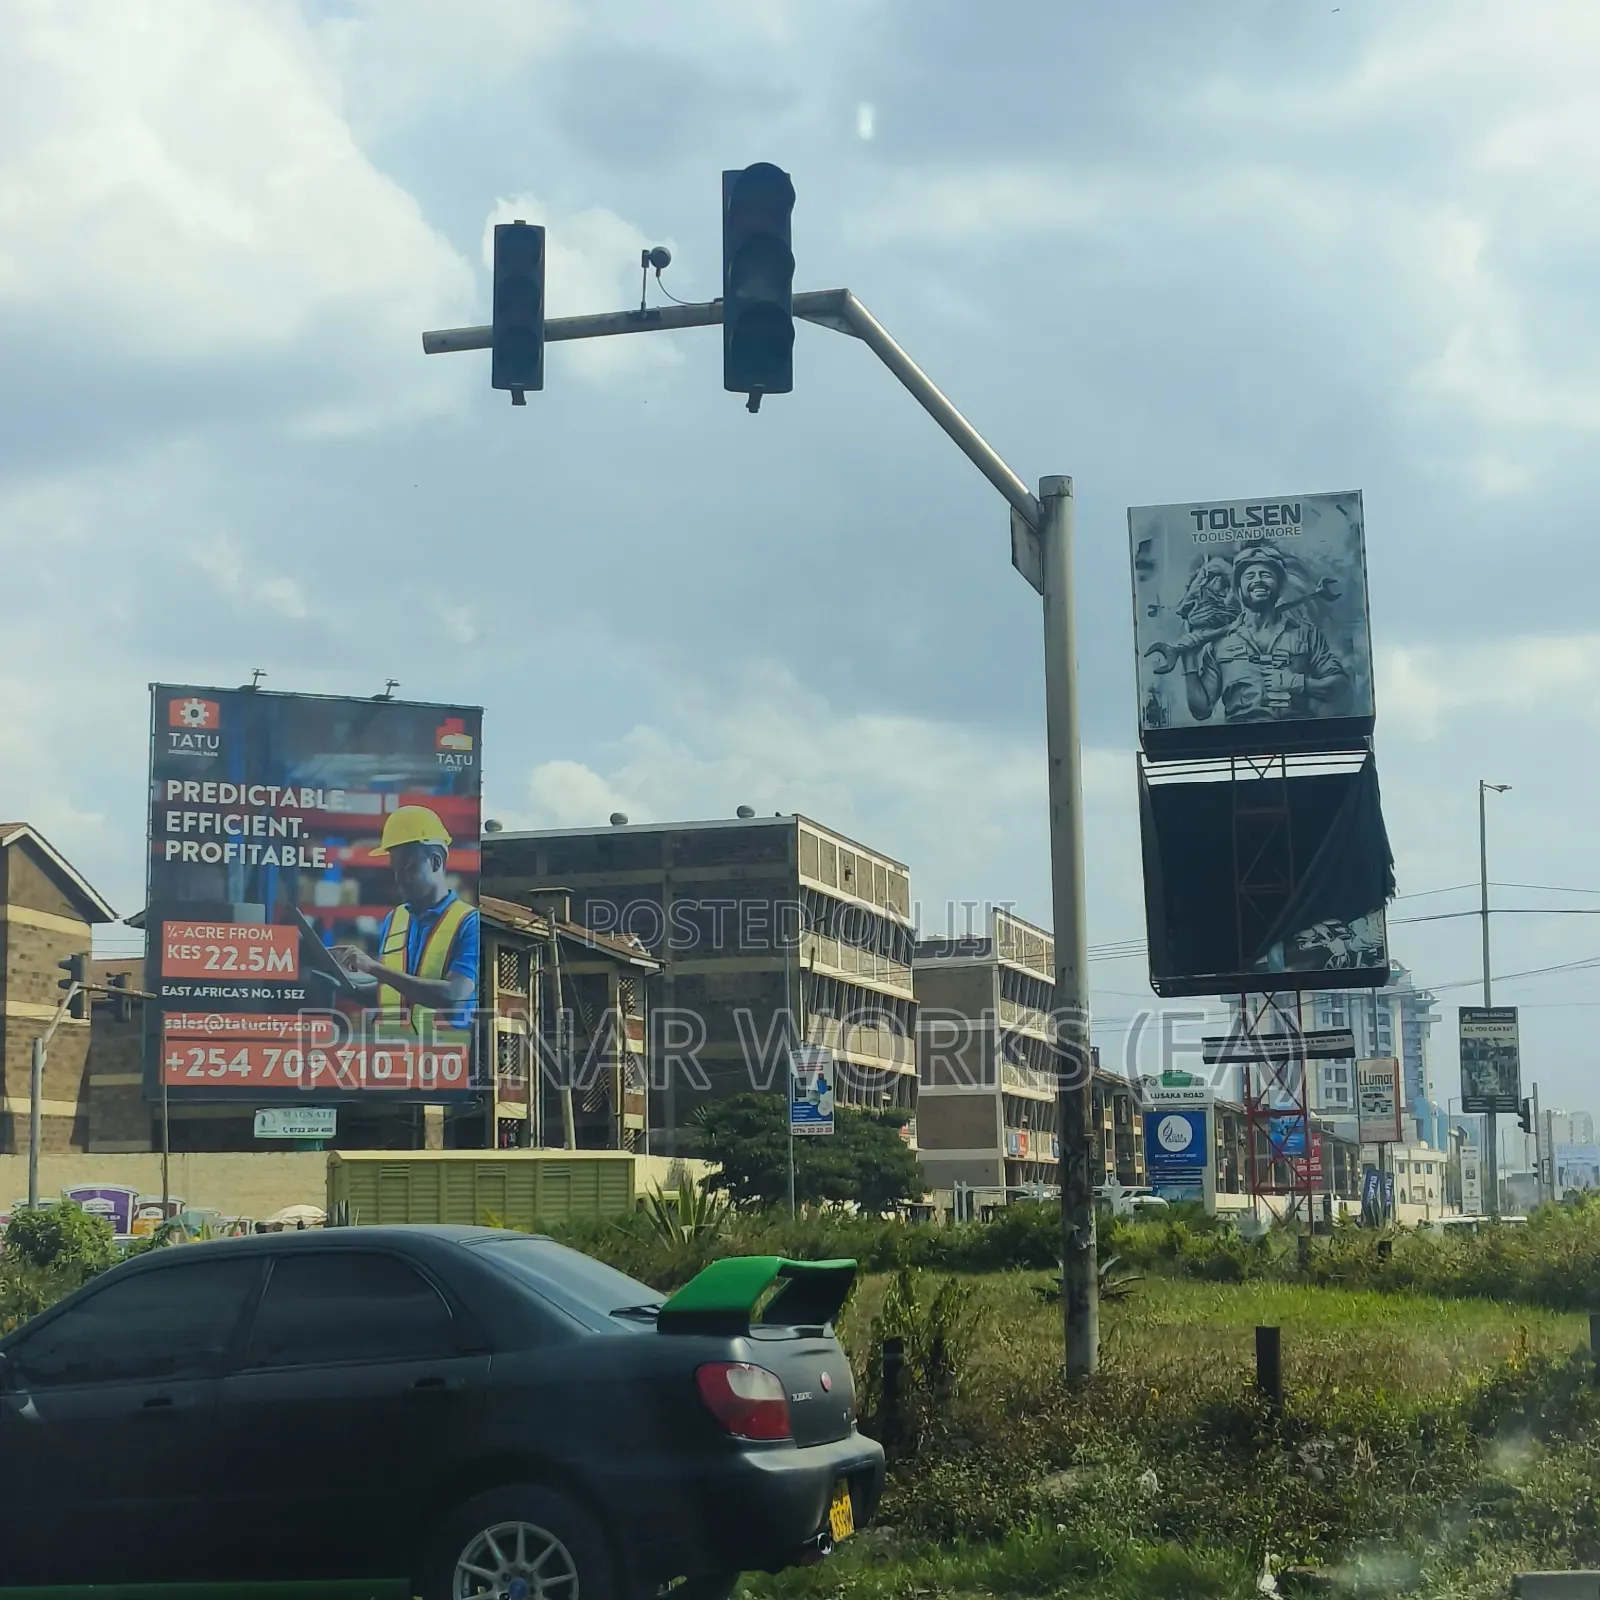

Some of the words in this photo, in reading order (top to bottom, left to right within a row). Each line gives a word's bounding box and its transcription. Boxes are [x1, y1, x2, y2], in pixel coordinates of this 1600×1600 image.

[1190, 503, 1301, 531] TOLSEN
[1191, 531, 1233, 543] TOOLS
[1236, 529, 1262, 540] AND
[1266, 526, 1302, 538] MORE
[168, 732, 220, 749] TATU
[435, 753, 473, 766] TATU
[167, 779, 350, 810] PREDICTABLE.
[166, 810, 310, 839] EFFICIENT.
[165, 839, 334, 869] PROFITABLE.
[229, 926, 273, 941] FROM
[167, 944, 201, 960] KES
[204, 945, 294, 972] 22.5M
[162, 985, 191, 996] EAST
[193, 986, 249, 998] AFRICA'S
[251, 988, 274, 999] NO.
[277, 989, 281, 998] 1
[284, 989, 305, 999] SEZ
[164, 1013, 328, 1037] sales@tatucity.com
[165, 1047, 251, 1078] +254
[262, 1048, 328, 1079] 709
[336, 1050, 393, 1080] 710
[403, 1051, 463, 1081] 100
